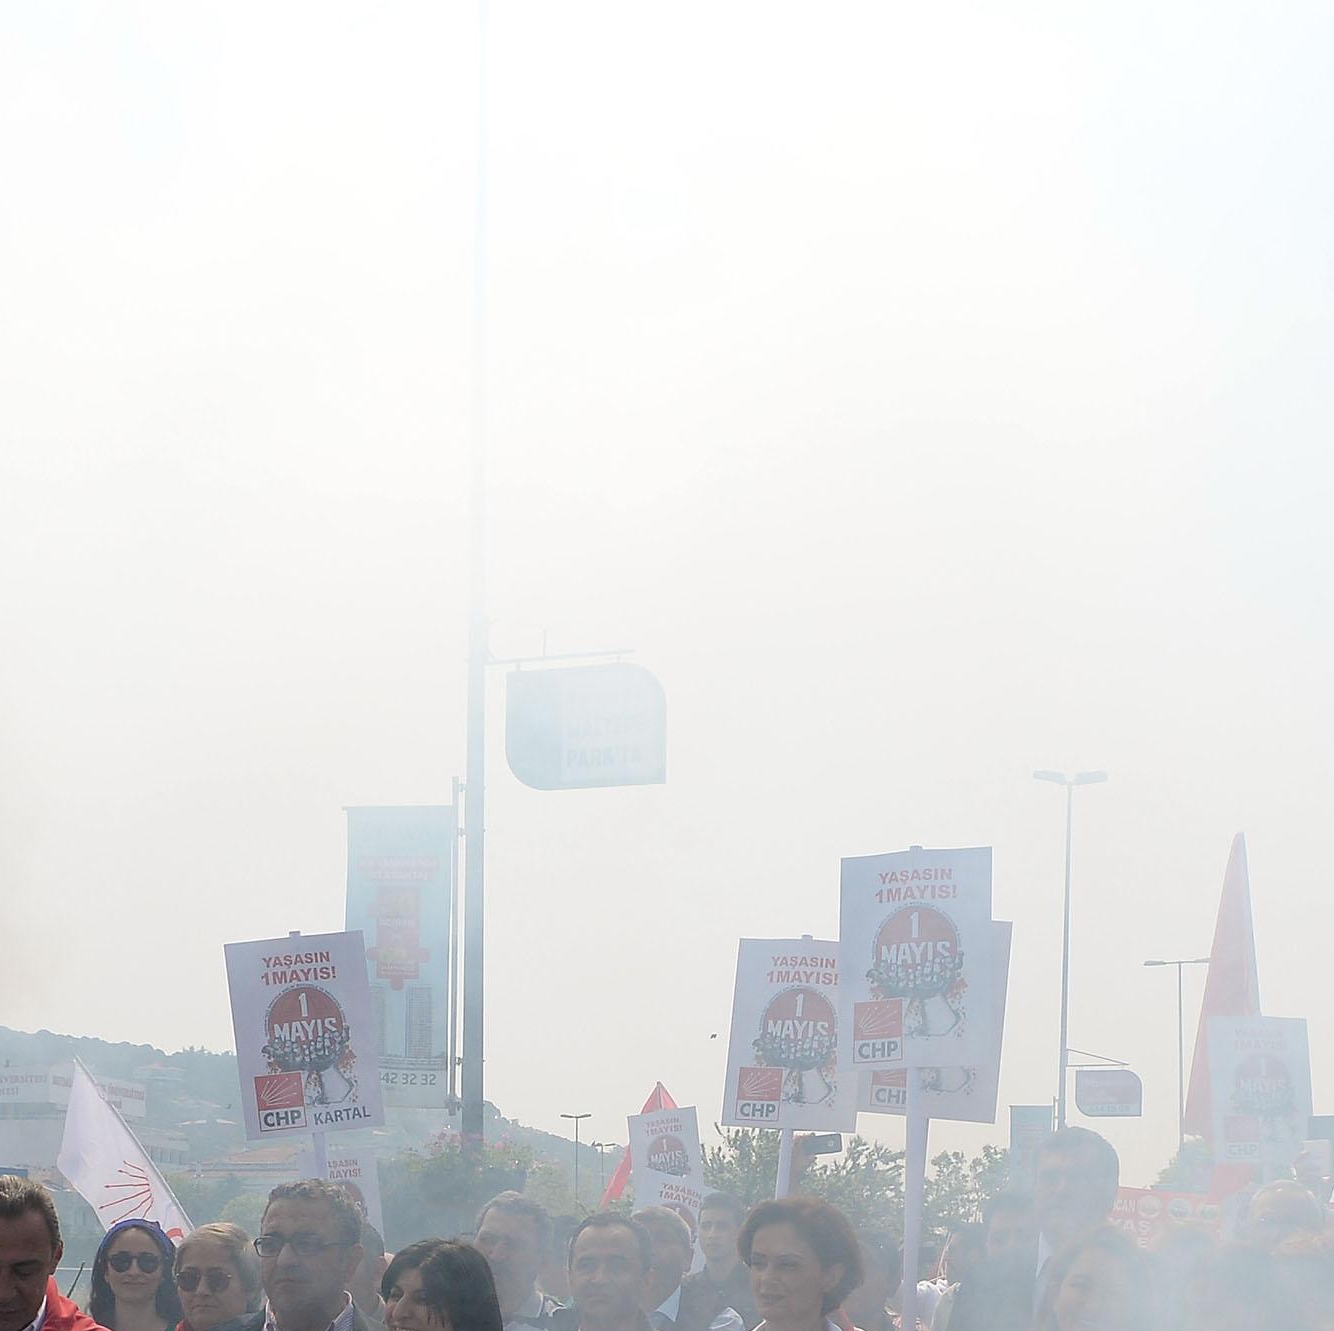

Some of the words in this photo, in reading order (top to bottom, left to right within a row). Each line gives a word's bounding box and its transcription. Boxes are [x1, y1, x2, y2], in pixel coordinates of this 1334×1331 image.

[878, 867, 953, 885] YAŞASIN
[909, 911, 920, 939] 1
[261, 950, 331, 969] YAŞASIN
[771, 955, 836, 970] YAŞASIN
[880, 941, 951, 966] MAYIS
[298, 992, 309, 1018] 1
[795, 993, 804, 1018] 1
[273, 1017, 338, 1043] MAYIS
[767, 1019, 829, 1040] MAYIS
[857, 1041, 899, 1060] CHP
[380, 1072, 398, 1085] 42
[402, 1073, 418, 1086] 32
[421, 1073, 437, 1086] 32
[262, 1109, 302, 1129] CHP
[314, 1105, 372, 1126] KARTAL
[739, 1102, 776, 1118] CHP
